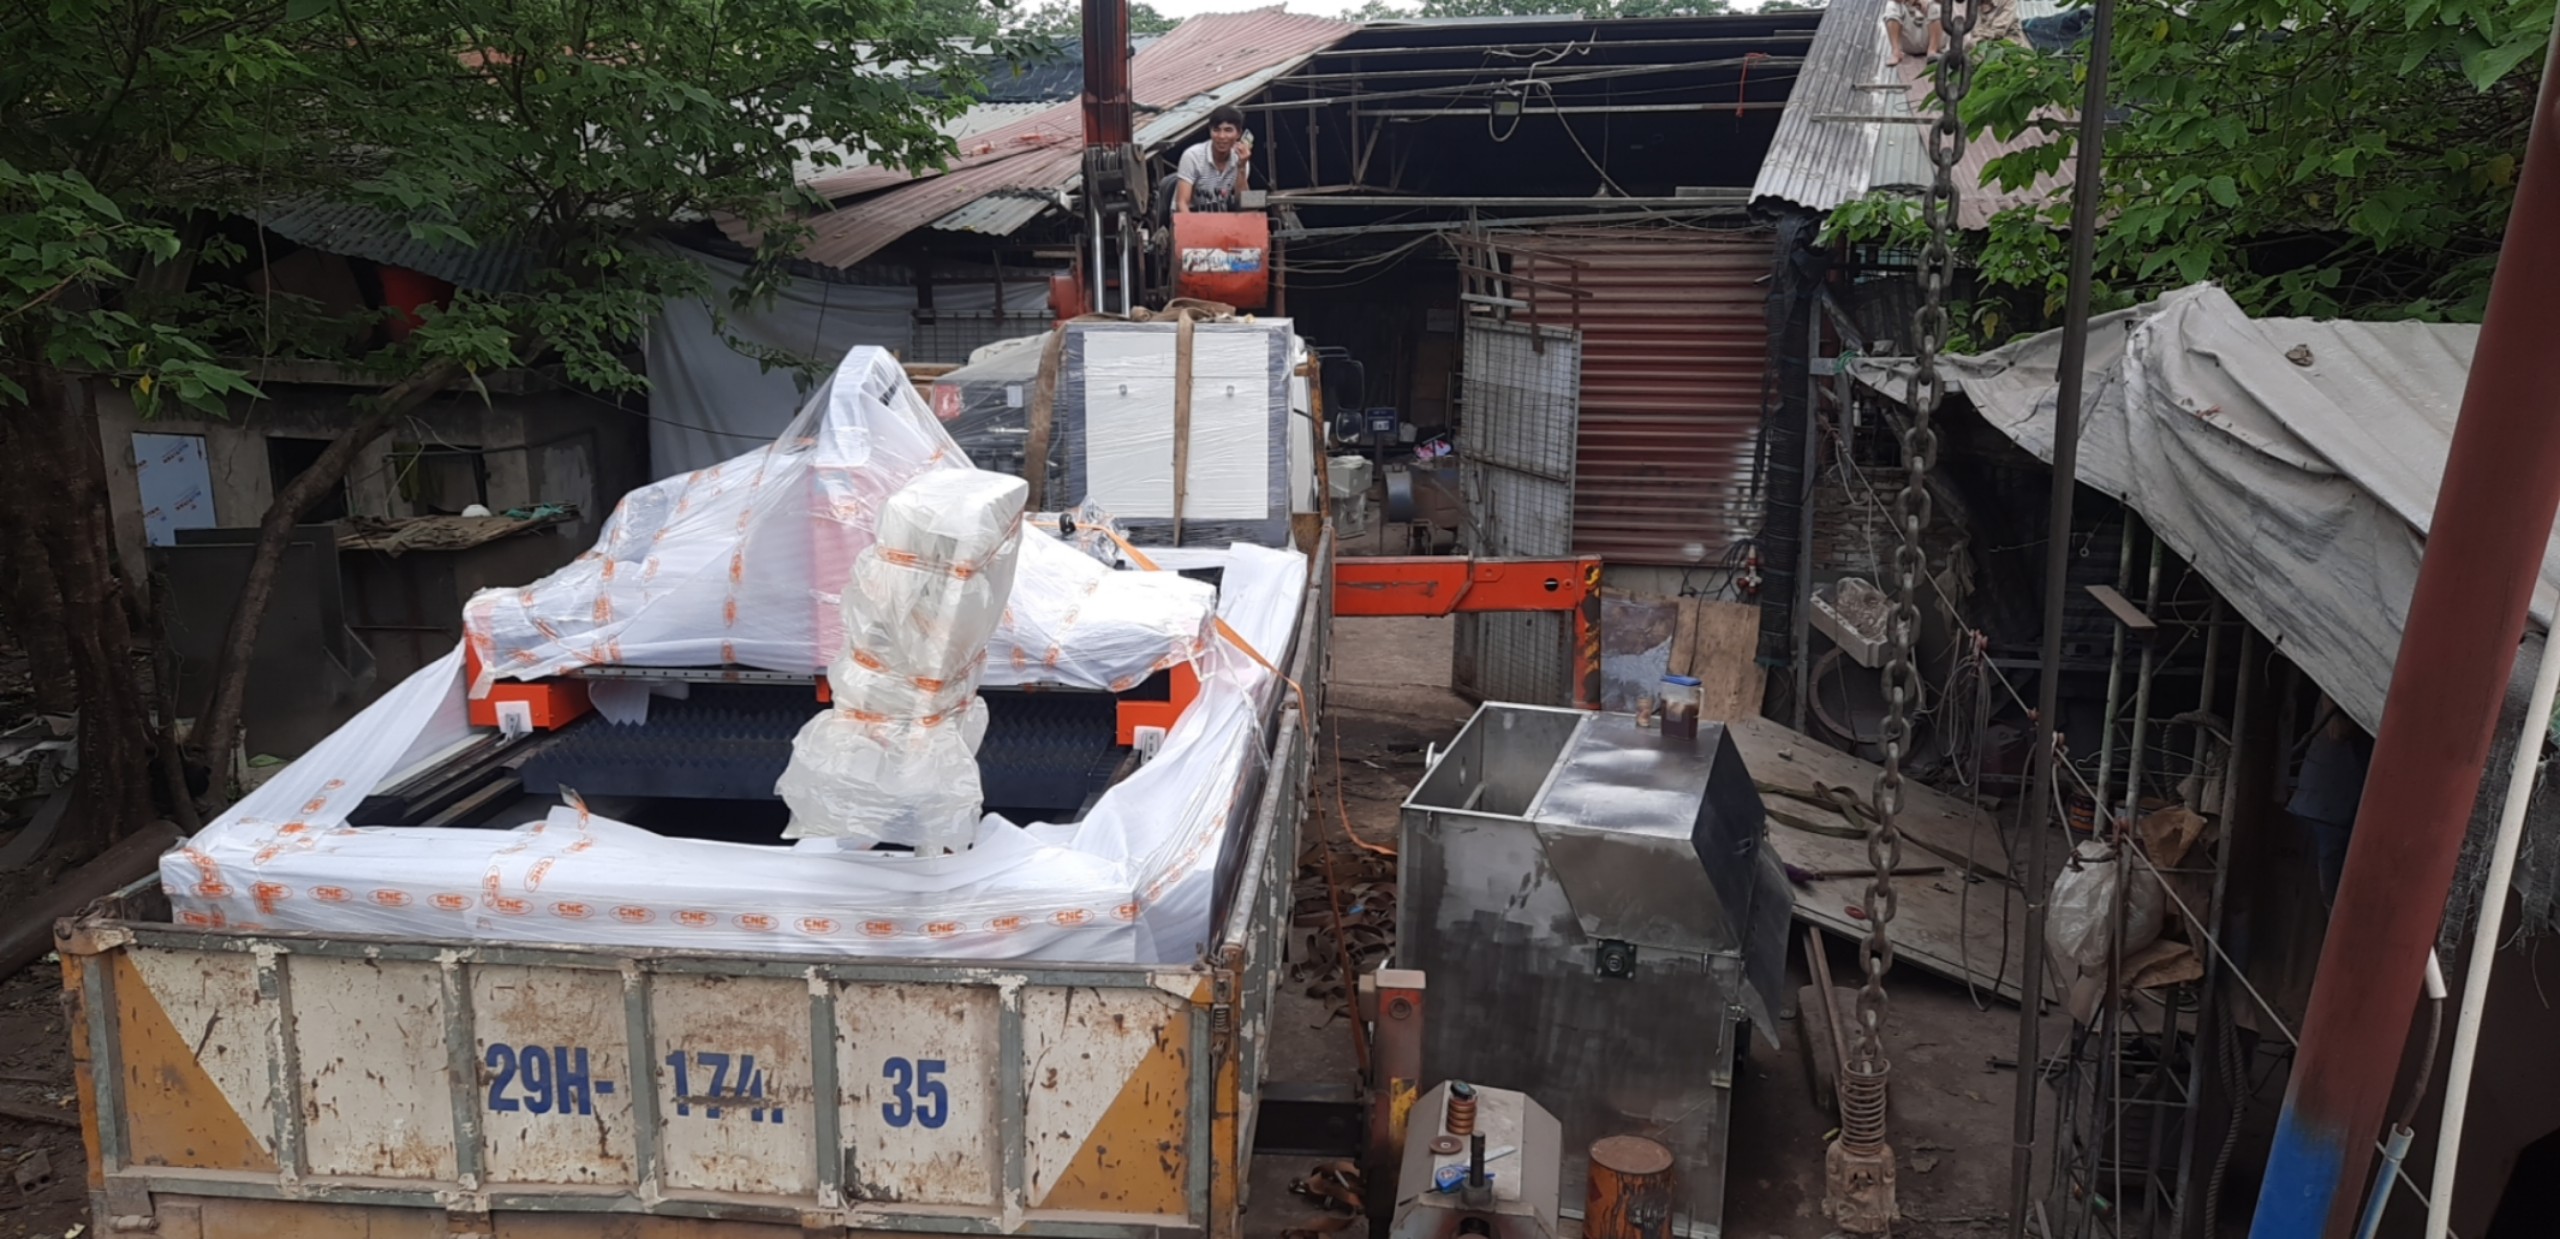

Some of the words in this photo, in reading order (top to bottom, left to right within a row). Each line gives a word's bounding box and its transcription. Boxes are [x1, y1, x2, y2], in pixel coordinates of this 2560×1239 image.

[316, 887, 342, 897] CNC
[376, 891, 402, 900] CNC
[436, 895, 462, 905] CNC
[497, 899, 523, 909] CNC
[557, 903, 584, 913] CNC
[618, 907, 645, 917] CNC
[680, 911, 706, 921] CNC
[742, 915, 768, 925] CNC
[1057, 909, 1083, 922] CNC
[804, 919, 829, 929] CNC
[866, 922, 892, 931] CNC
[993, 917, 1019, 928] CNC
[928, 923, 955, 933] CNC
[486, 1043, 614, 1116] 29H-
[881, 1056, 948, 1129] 35
